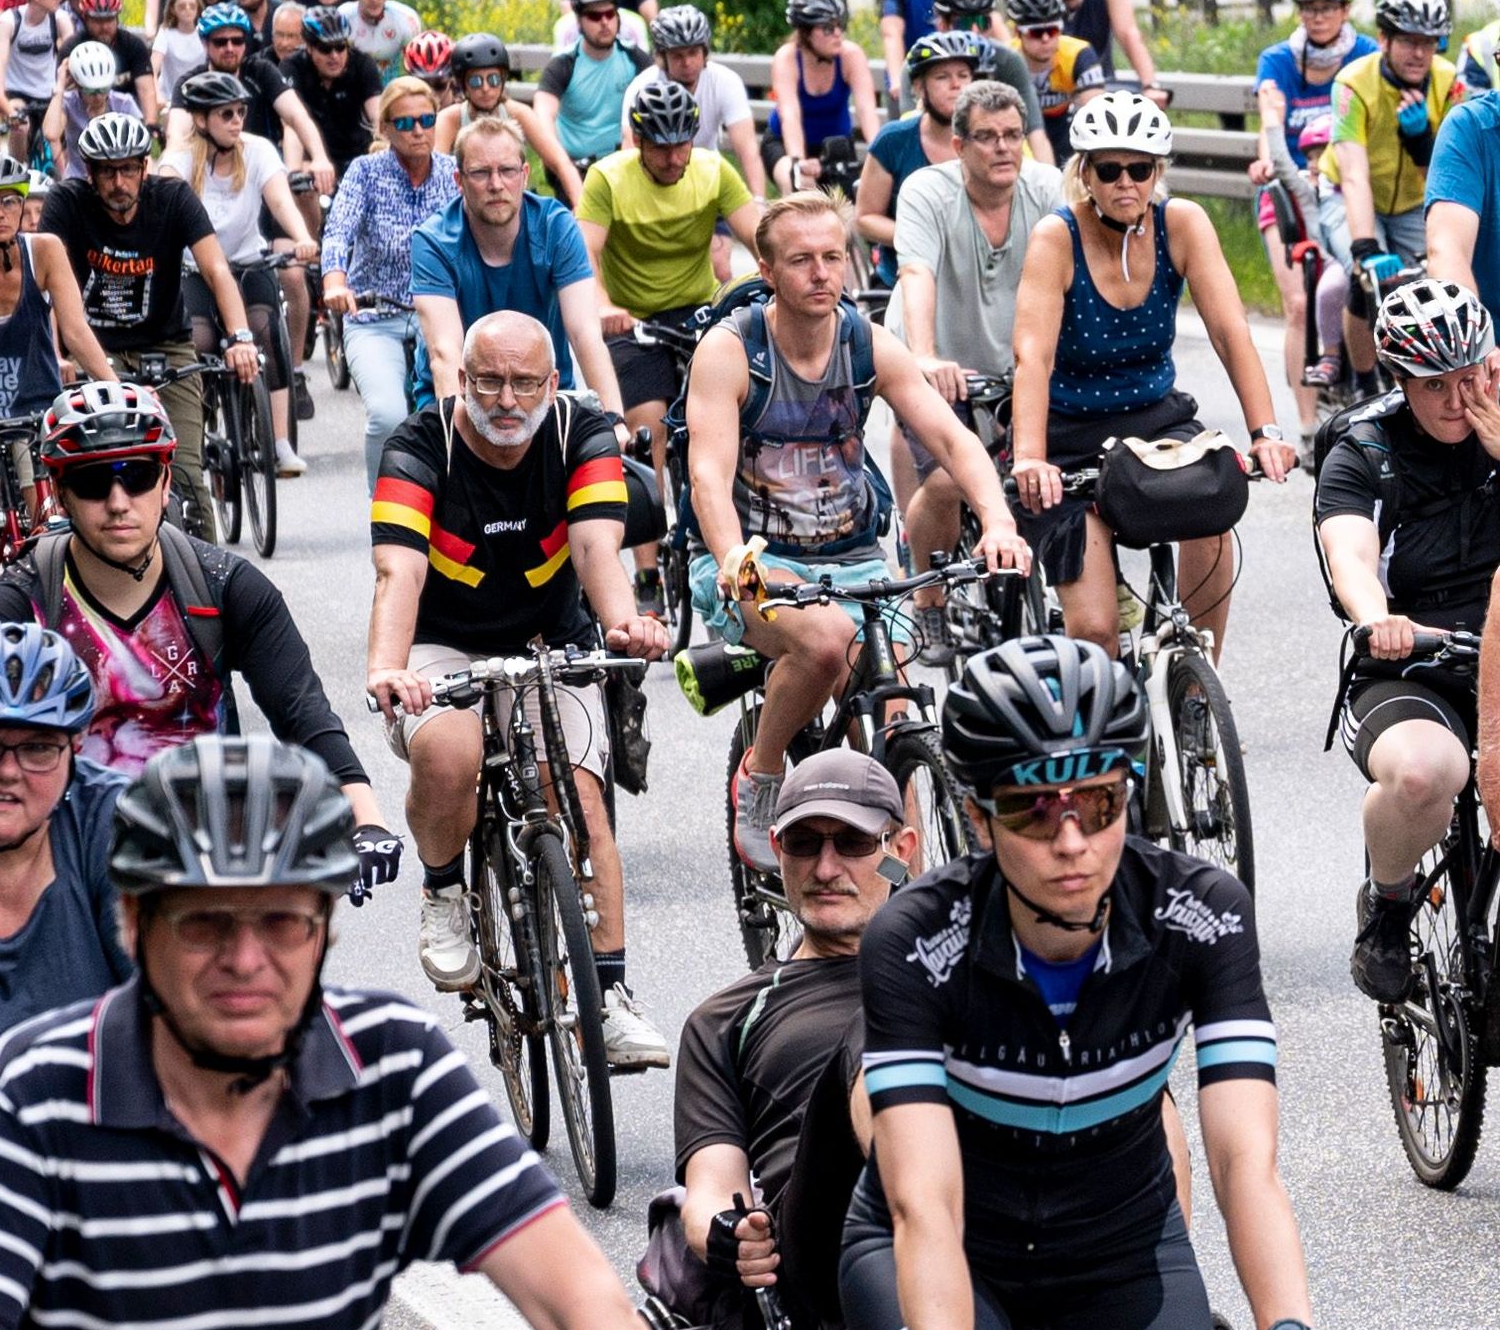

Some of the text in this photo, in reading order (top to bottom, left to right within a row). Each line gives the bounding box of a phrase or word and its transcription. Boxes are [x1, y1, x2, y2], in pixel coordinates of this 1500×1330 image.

[779, 447, 838, 478] LIFE
[484, 518, 527, 534] GERMANY
[1013, 751, 1121, 786] KULT
[960, 1043, 1046, 1068] LLGÄU
